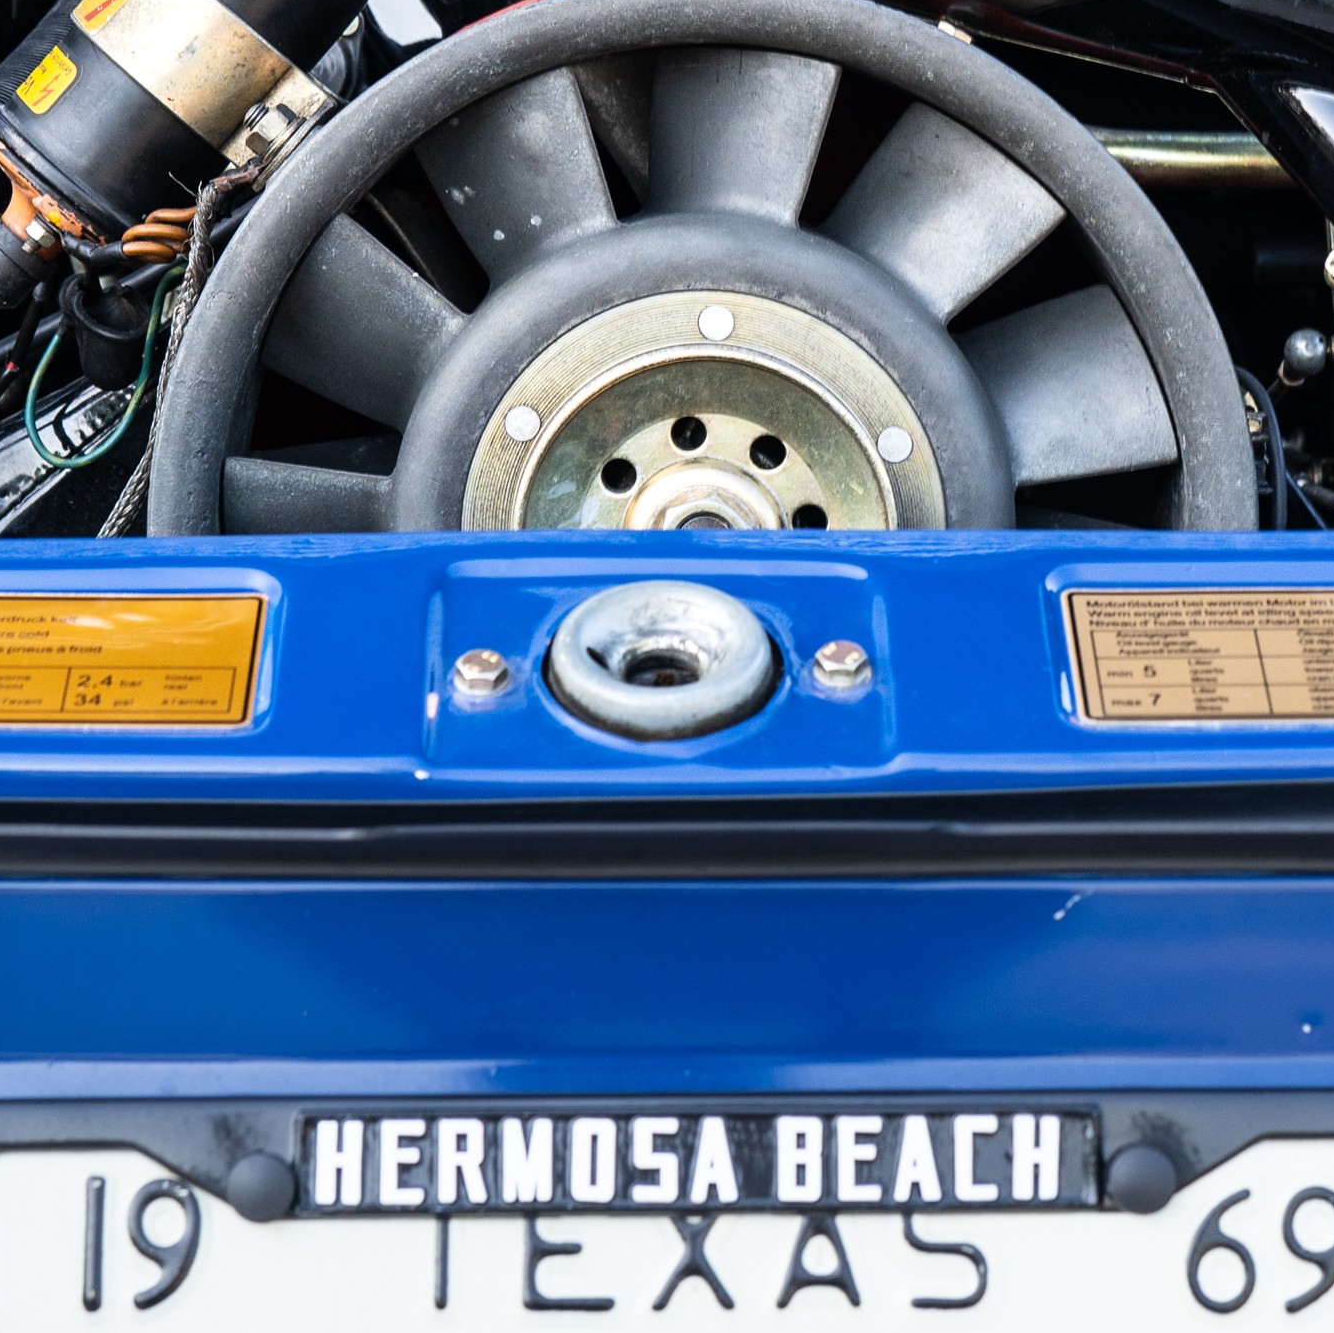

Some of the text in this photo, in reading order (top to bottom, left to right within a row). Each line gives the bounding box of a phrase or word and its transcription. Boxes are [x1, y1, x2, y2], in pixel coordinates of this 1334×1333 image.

[18, 630, 50, 638] cold
[7, 645, 53, 655] pneus
[69, 645, 103, 654] froid
[1107, 670, 1133, 678] min
[74, 693, 101, 706] 34
[1149, 693, 1161, 707] 7
[314, 1113, 1060, 1206] HERMOSA BEACH
[83, 1175, 201, 1312] 19
